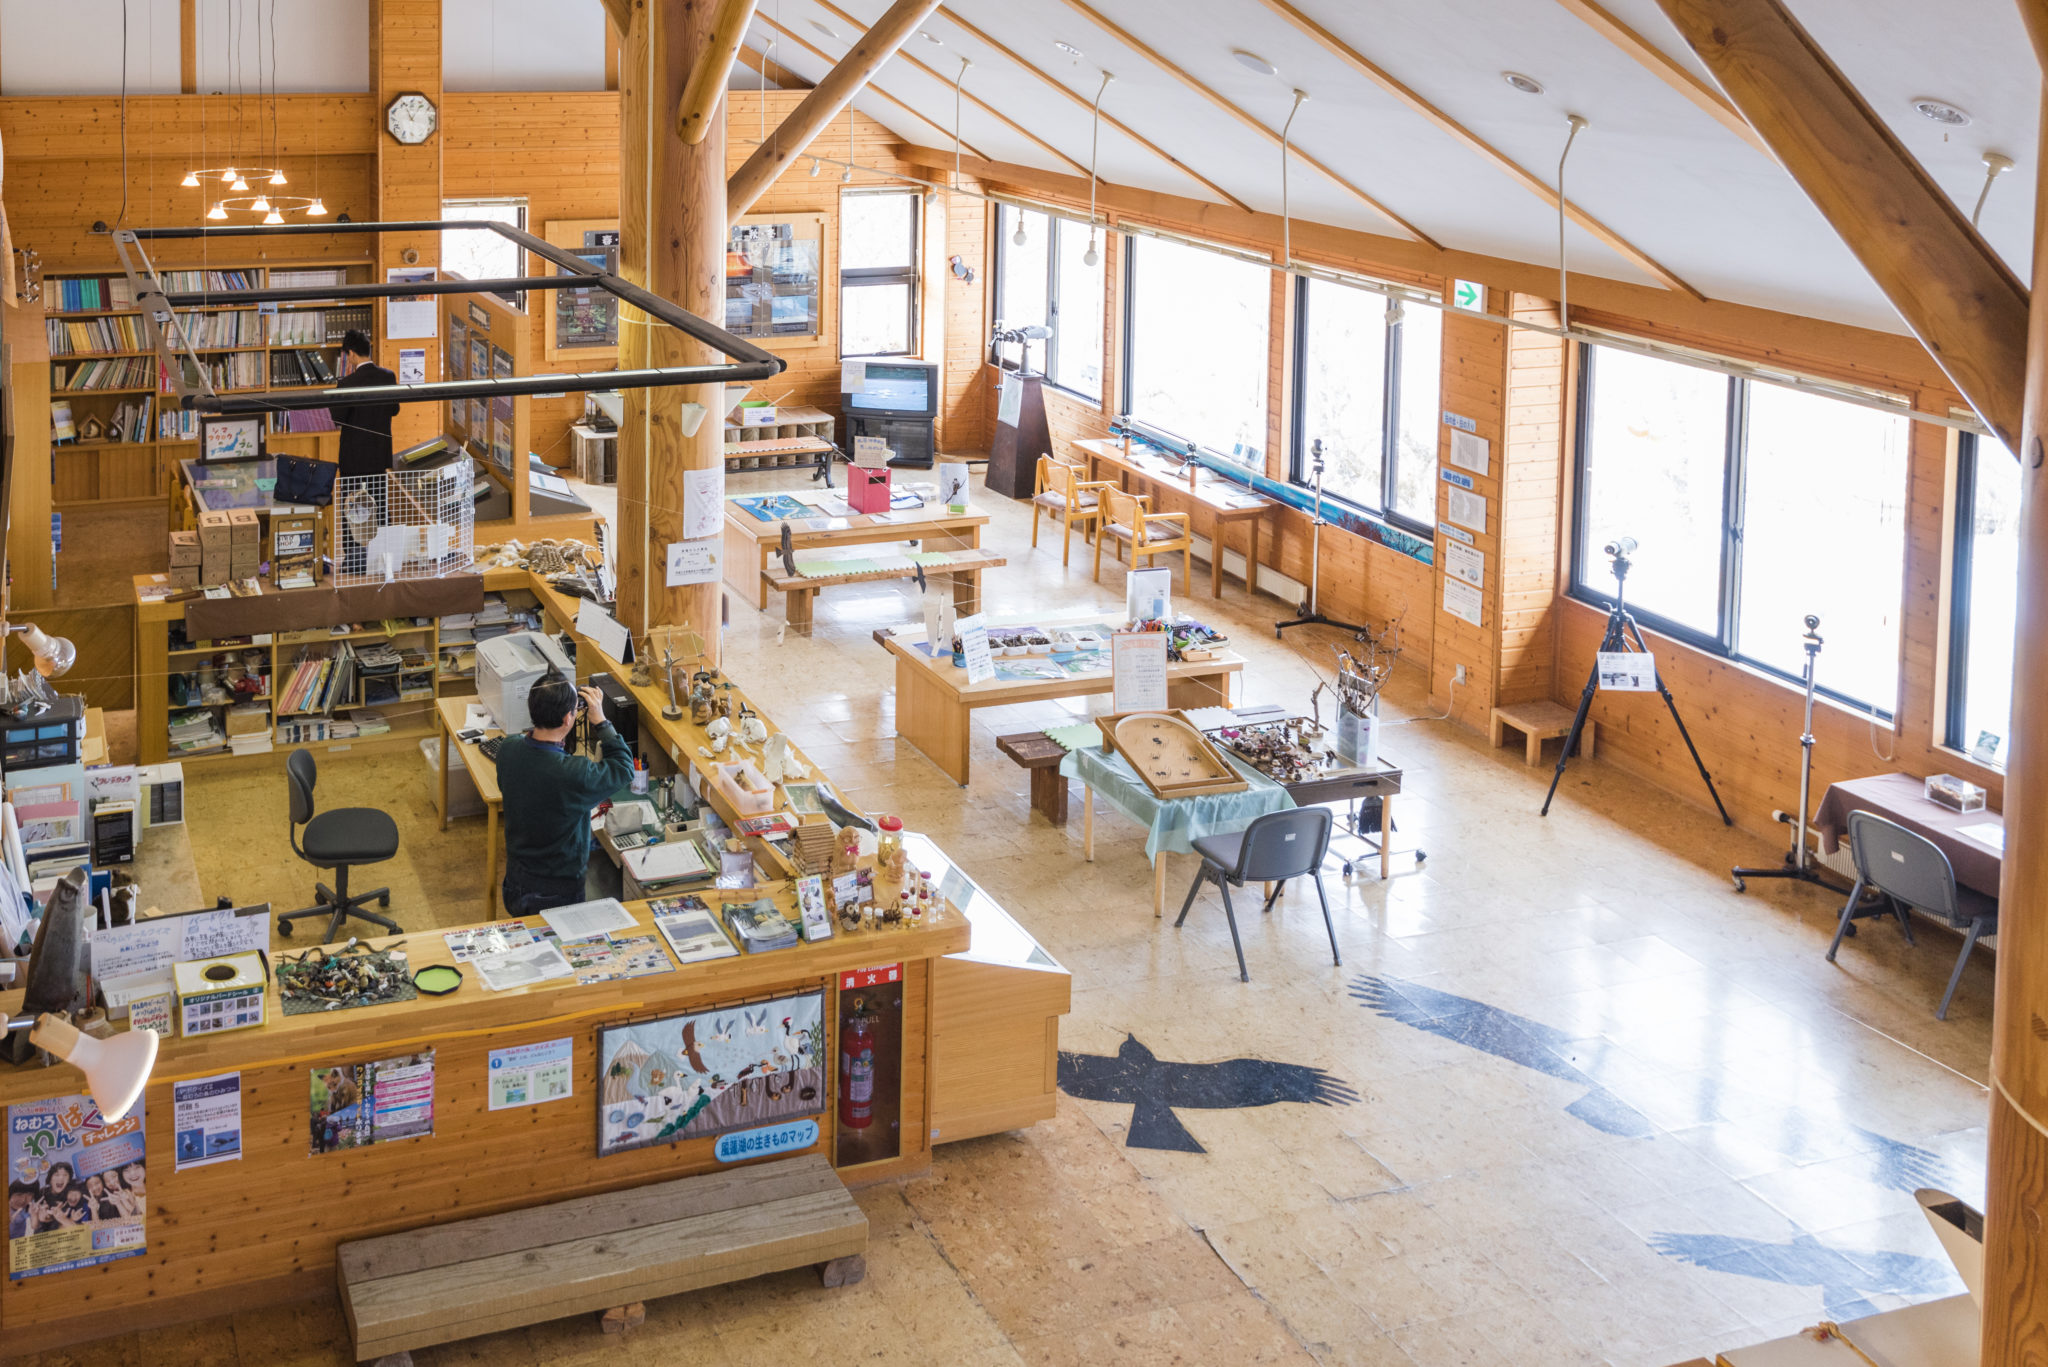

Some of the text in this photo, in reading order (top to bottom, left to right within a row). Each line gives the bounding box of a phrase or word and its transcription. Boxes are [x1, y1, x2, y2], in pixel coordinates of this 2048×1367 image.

[15, 1116, 55, 1131] ねむろ
[85, 1118, 136, 1143] チャレンジ
[721, 1126, 813, 1156] 風蓮湖の生きものマップ
